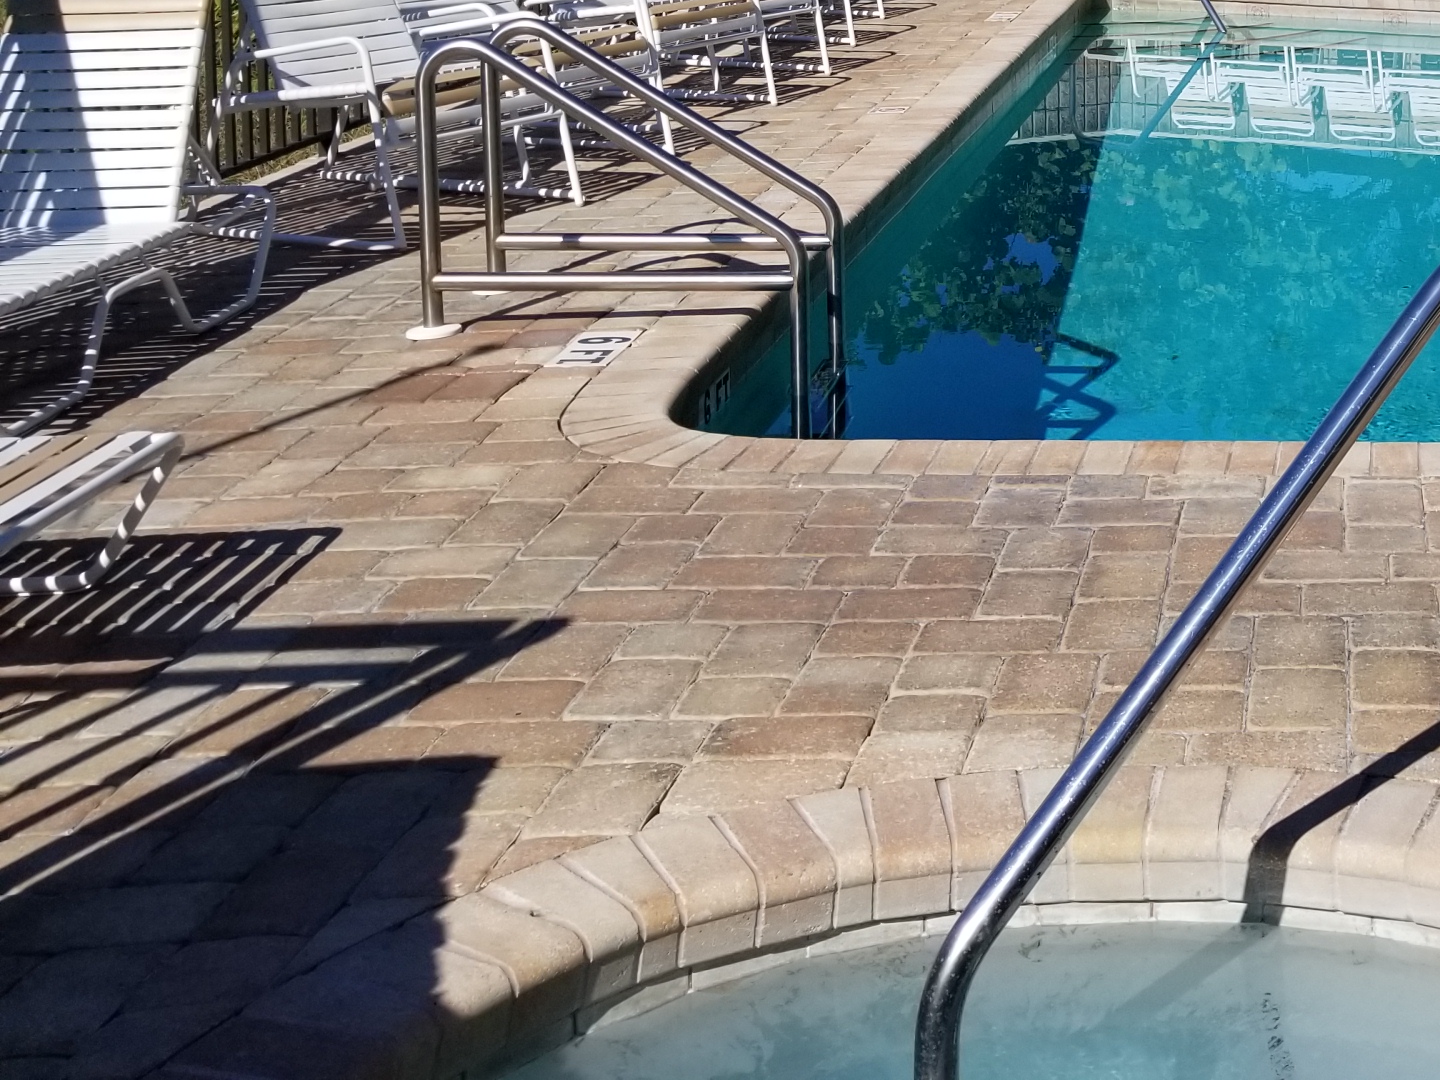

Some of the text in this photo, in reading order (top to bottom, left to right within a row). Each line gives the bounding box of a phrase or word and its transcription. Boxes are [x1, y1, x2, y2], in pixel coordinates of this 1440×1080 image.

[556, 336, 632, 365] 6 FT
[716, 371, 729, 411] FT
